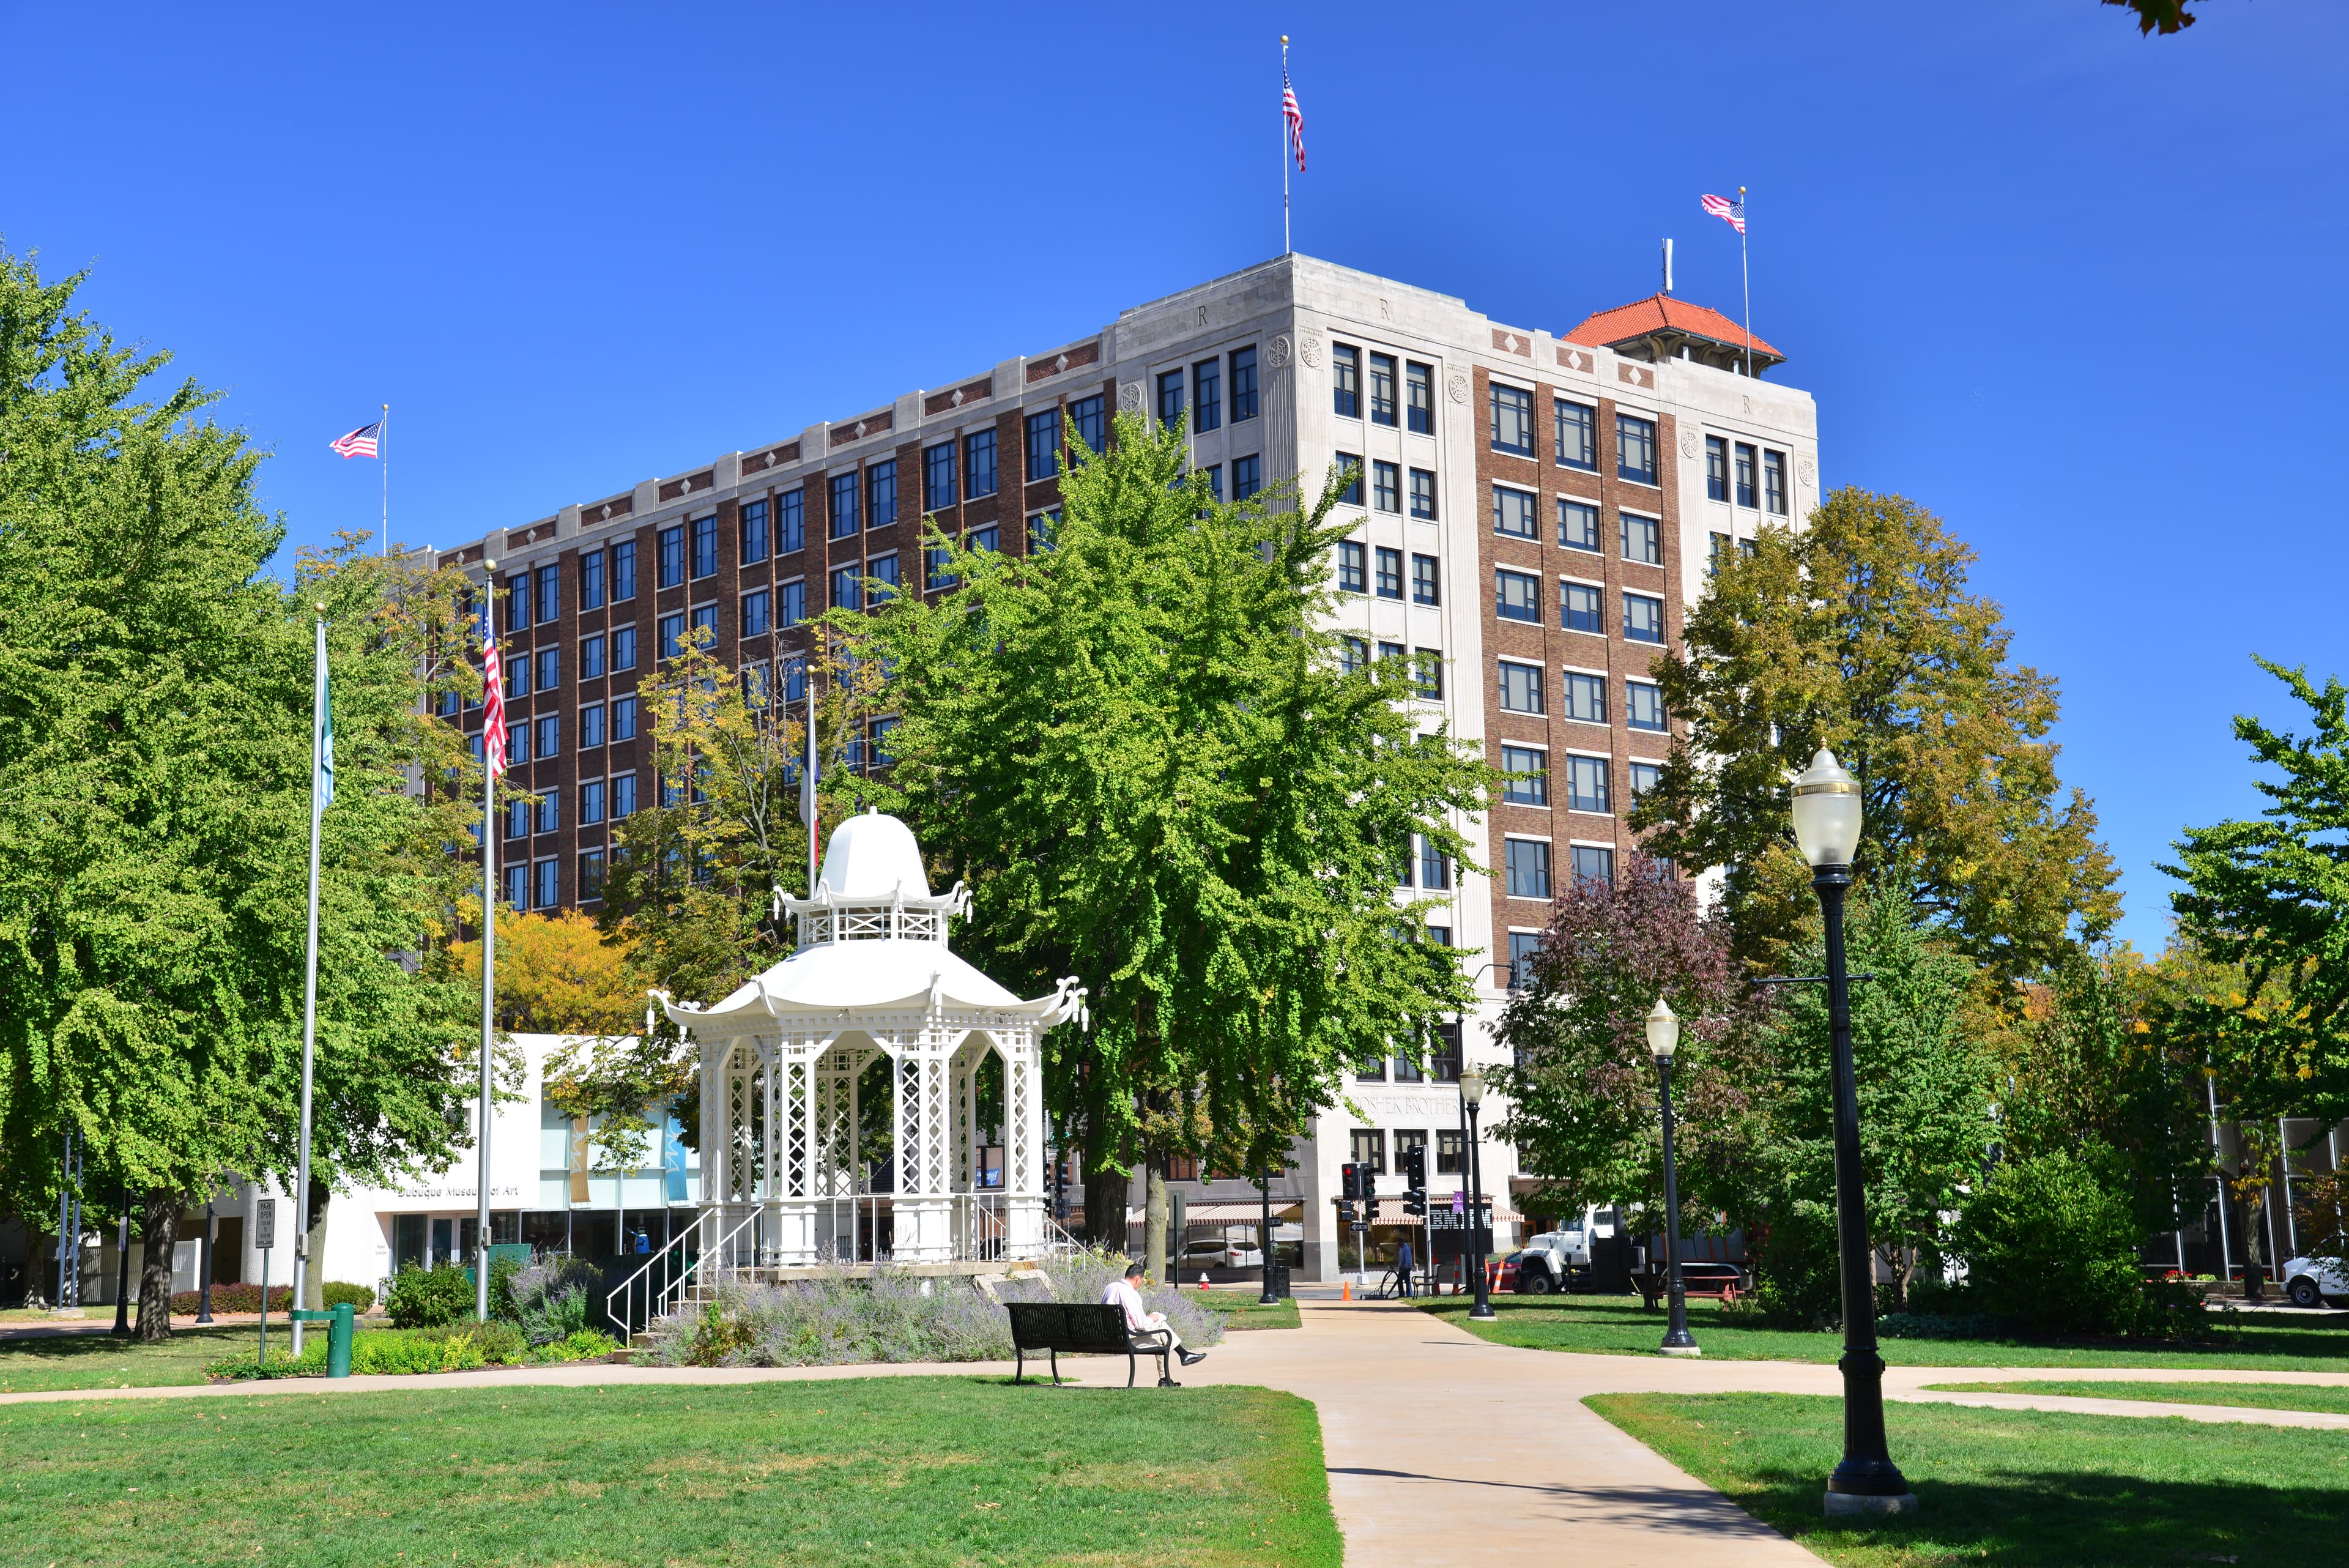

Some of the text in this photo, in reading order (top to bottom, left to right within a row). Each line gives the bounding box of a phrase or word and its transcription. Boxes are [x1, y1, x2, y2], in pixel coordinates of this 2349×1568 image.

[1198, 306, 1208, 327] R
[1380, 299, 1390, 320] R
[1743, 395, 1751, 415] R
[1406, 1098, 1460, 1115] BROTHER
[446, 1186, 477, 1196] Museu
[490, 1186, 500, 1195] of
[503, 1185, 519, 1195] Art
